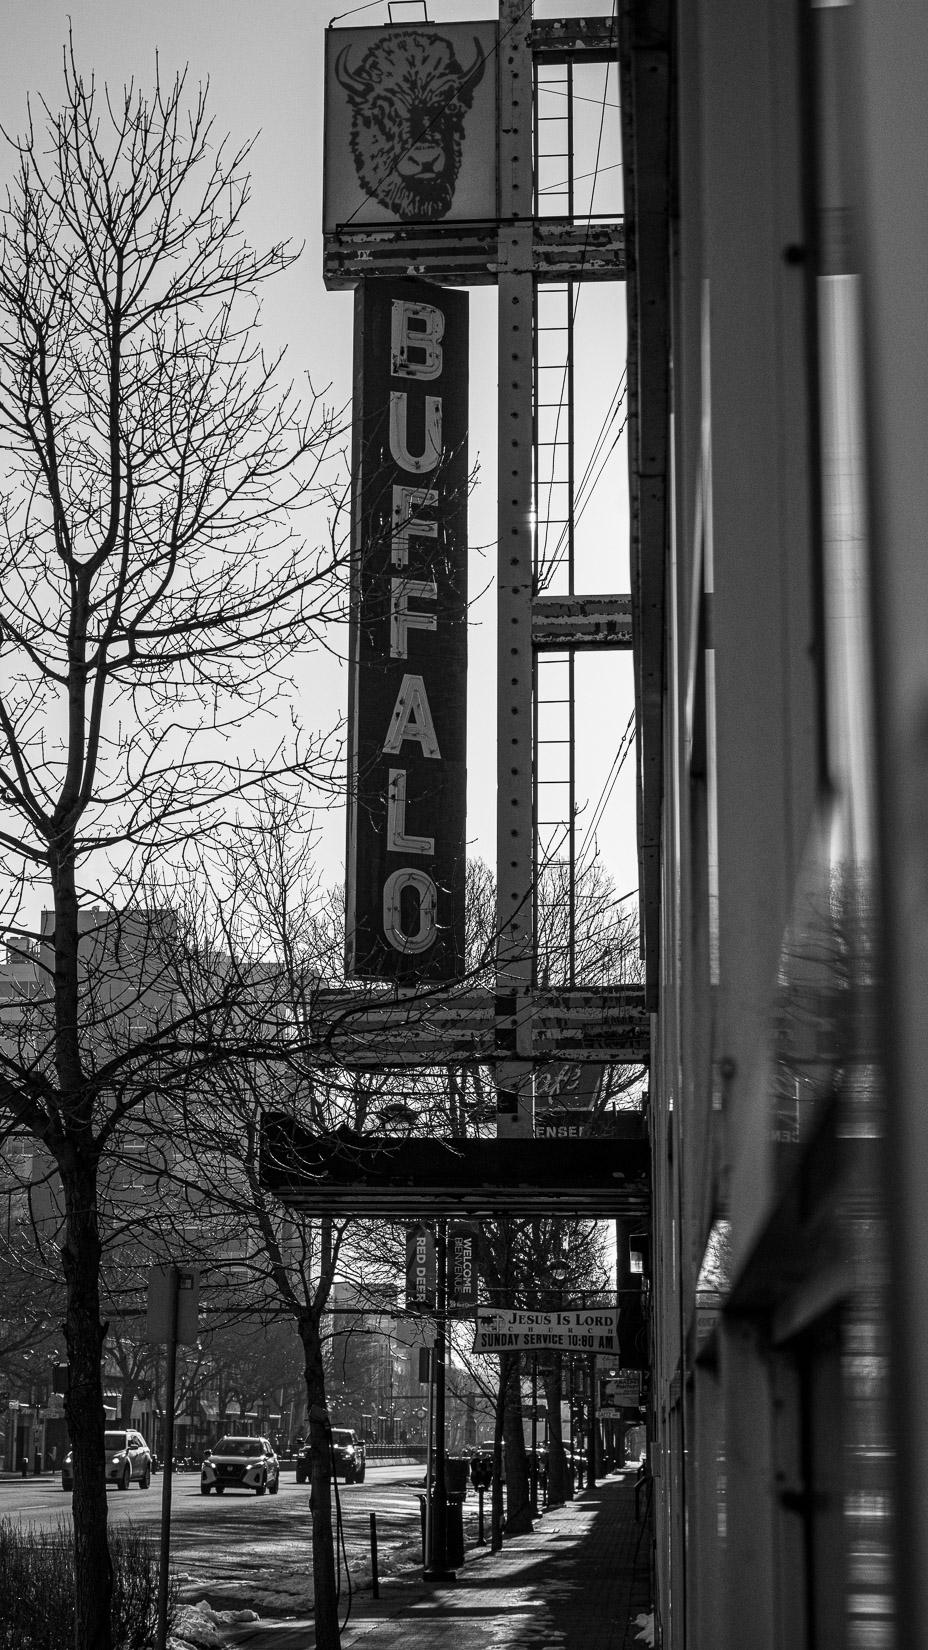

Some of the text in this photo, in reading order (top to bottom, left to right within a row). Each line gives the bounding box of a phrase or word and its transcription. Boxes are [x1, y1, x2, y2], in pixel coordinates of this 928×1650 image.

[382, 299, 446, 955] BUFFALO
[416, 1237, 426, 1302] RED DEER
[462, 1237, 473, 1294] WELCOME
[481, 1333, 519, 1347] SUNDAY
[523, 1333, 564, 1345] SERVICE
[598, 1335, 614, 1349] AM
